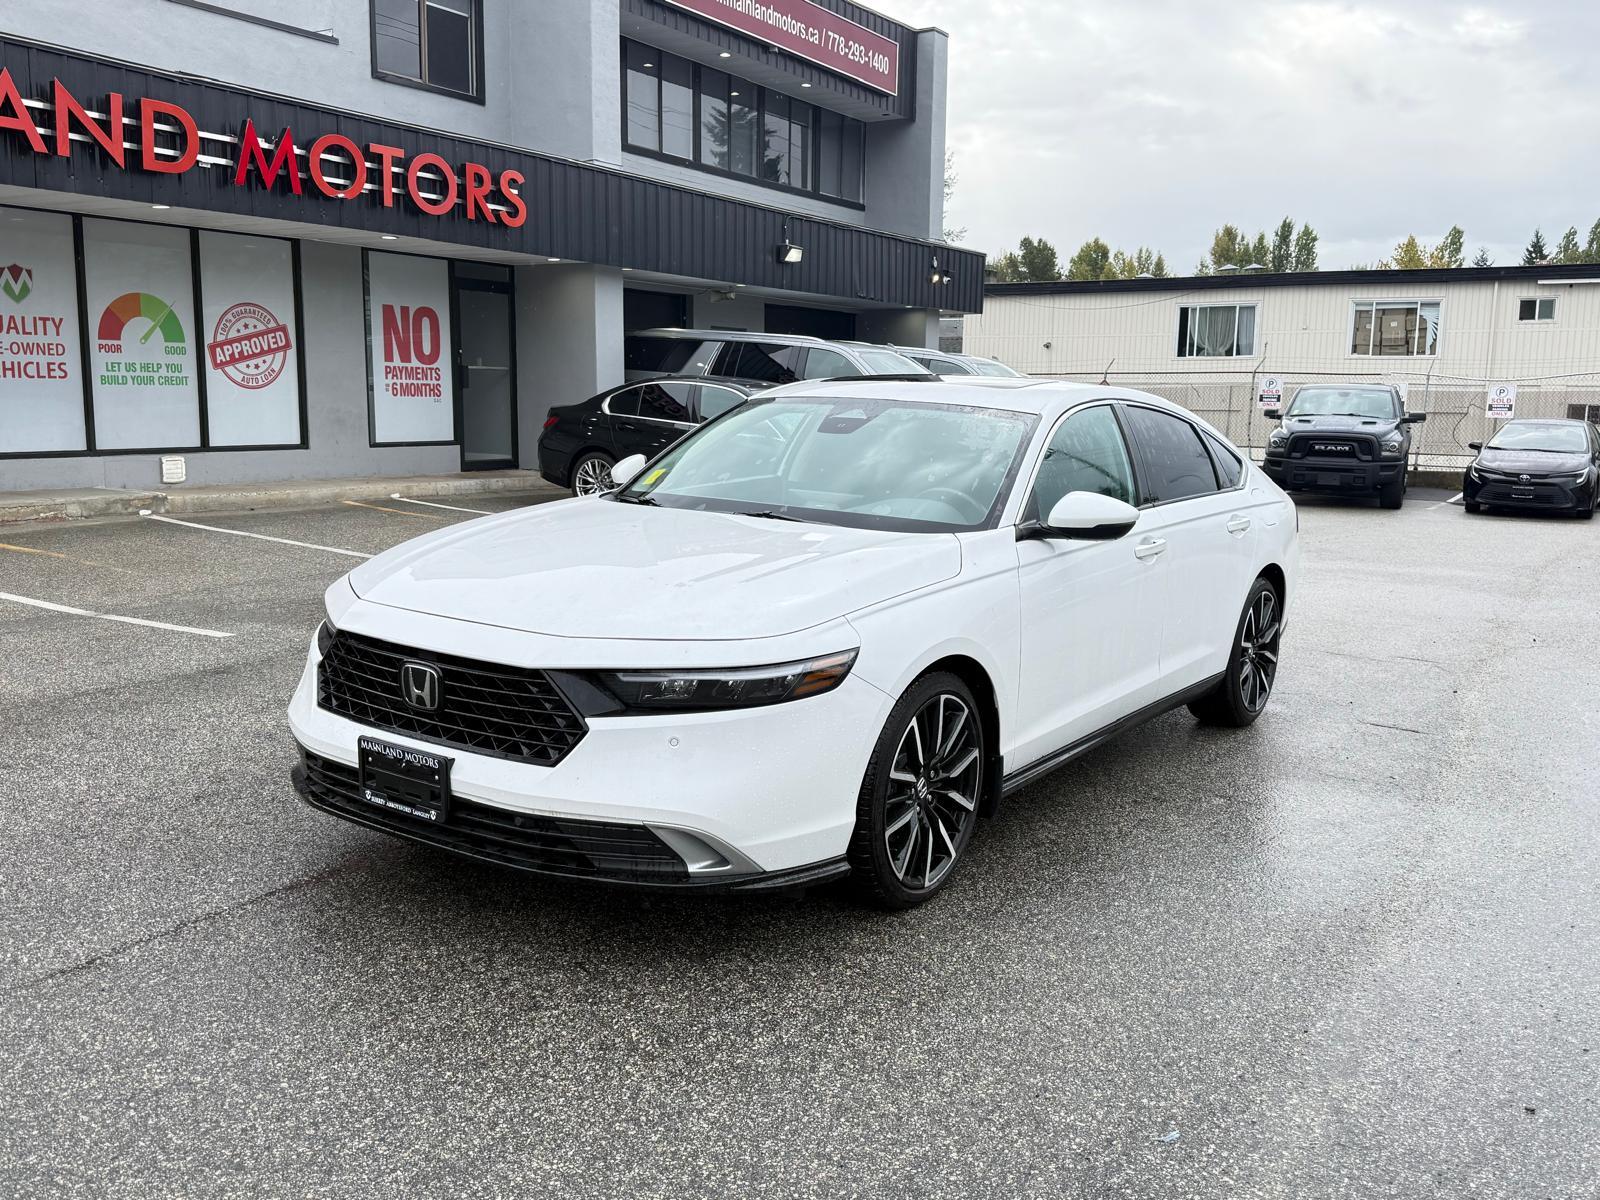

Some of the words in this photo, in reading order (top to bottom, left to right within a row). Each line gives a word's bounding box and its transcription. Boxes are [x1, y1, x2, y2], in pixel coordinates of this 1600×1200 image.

[828, 31, 889, 75] 778-293-1400
[0, 67, 200, 174] AND
[234, 118, 527, 227] MOTORS
[0, 315, 64, 336] ALITY
[219, 317, 233, 336] 100%
[231, 307, 272, 325] GUARANTEED
[382, 303, 441, 366] NO
[98, 343, 123, 354] POOR
[164, 345, 187, 356] GOOD
[215, 331, 286, 364] APPROVED
[105, 361, 121, 373] LET
[124, 362, 137, 373] US
[140, 362, 163, 373] HELP
[164, 362, 183, 374] YOU
[240, 375, 260, 385] AUTO
[261, 367, 277, 383] LOAN
[384, 365, 441, 381] PAYMENTS
[100, 374, 128, 386] BUILD
[130, 375, 156, 386] YOUR
[157, 375, 189, 386] CREDIT
[391, 382, 399, 397] 6
[400, 382, 442, 398] MONTHS
[361, 739, 403, 759] MAINLAND
[404, 751, 439, 769] MOTORS
